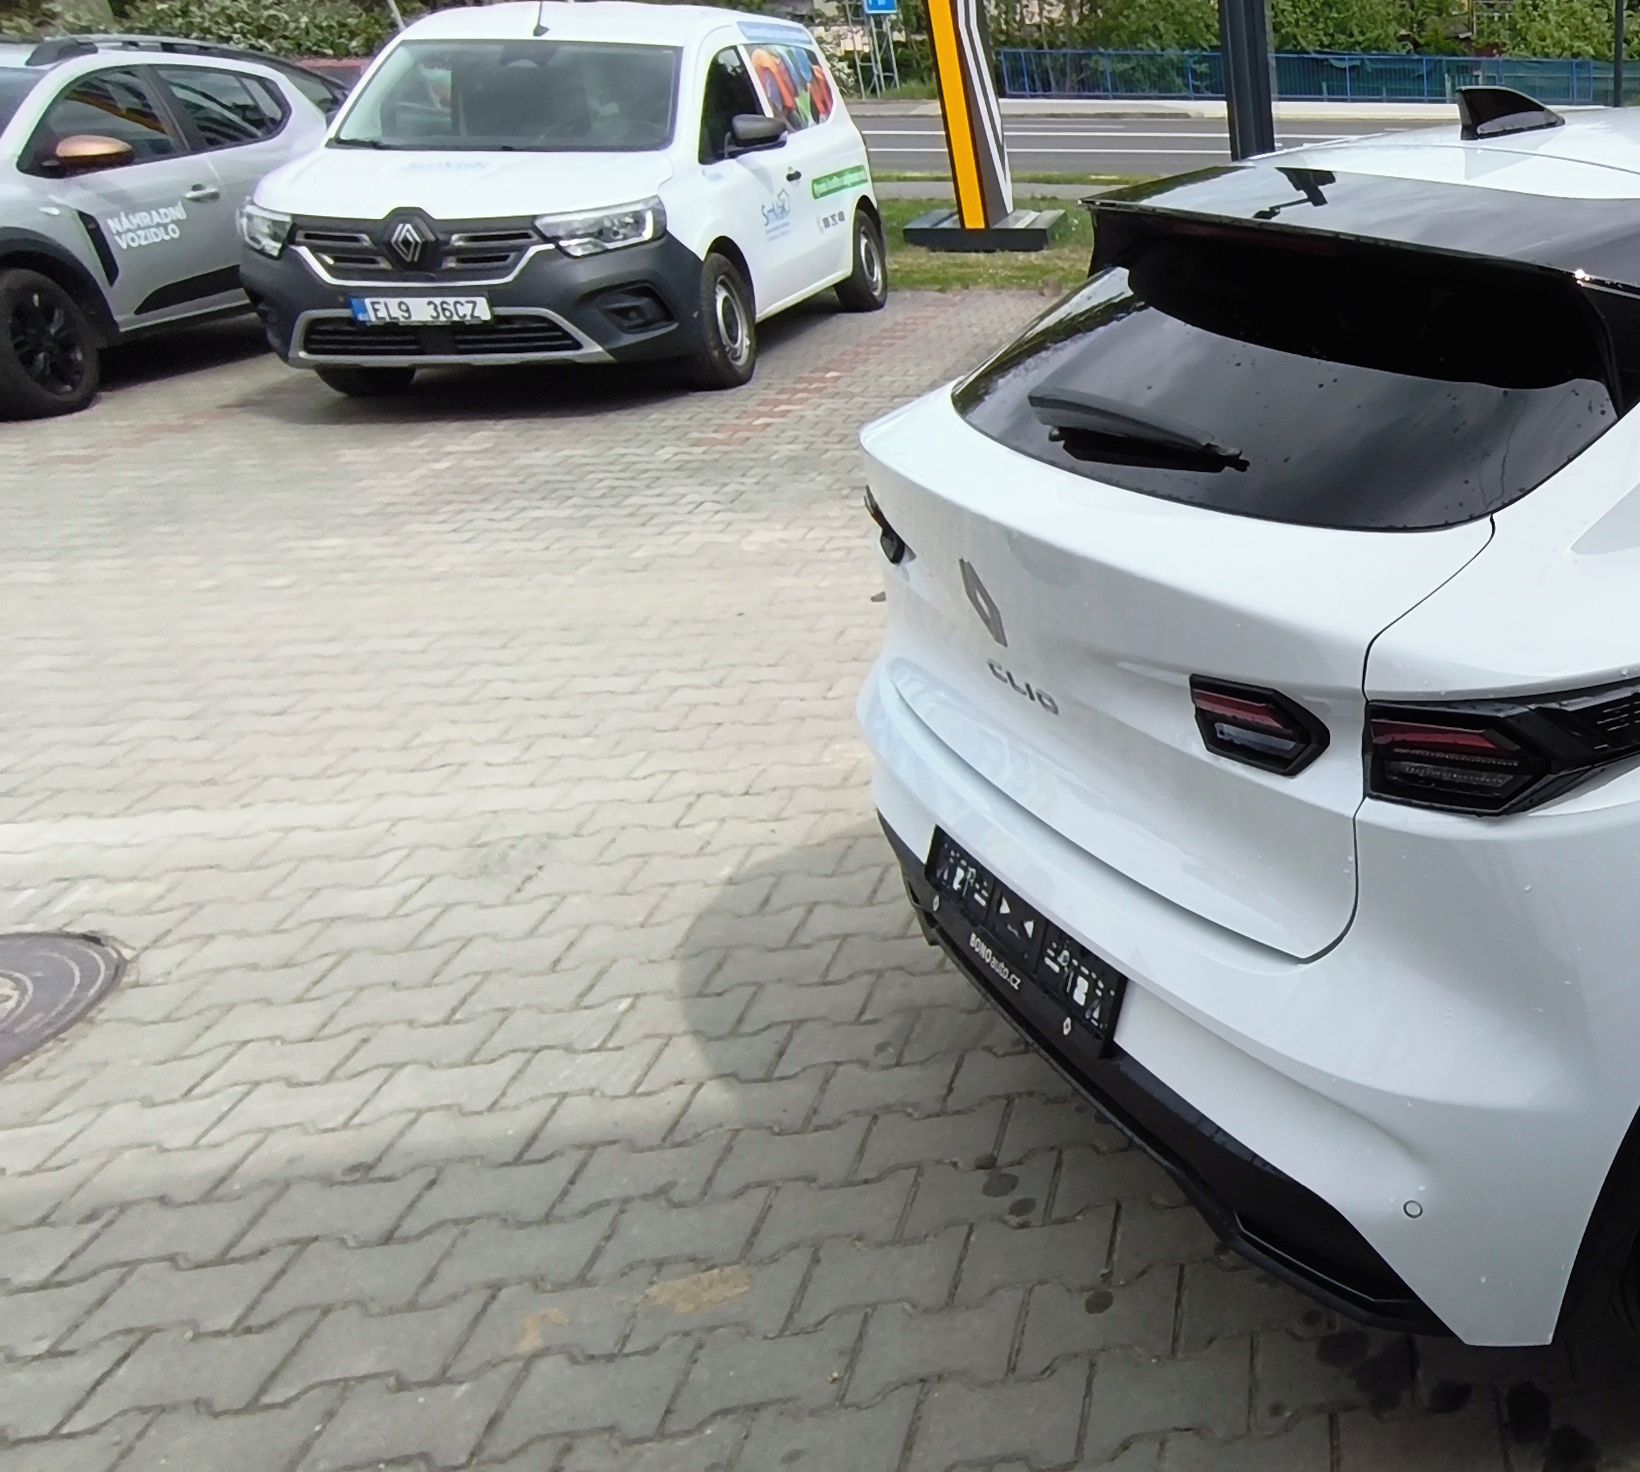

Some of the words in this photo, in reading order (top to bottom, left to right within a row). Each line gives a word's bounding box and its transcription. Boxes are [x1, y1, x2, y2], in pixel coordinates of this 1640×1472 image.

[114, 223, 180, 250] VOZIDLO
[370, 301, 412, 321] EL9
[427, 300, 482, 320] 36CZ
[986, 659, 1059, 716] CLIO
